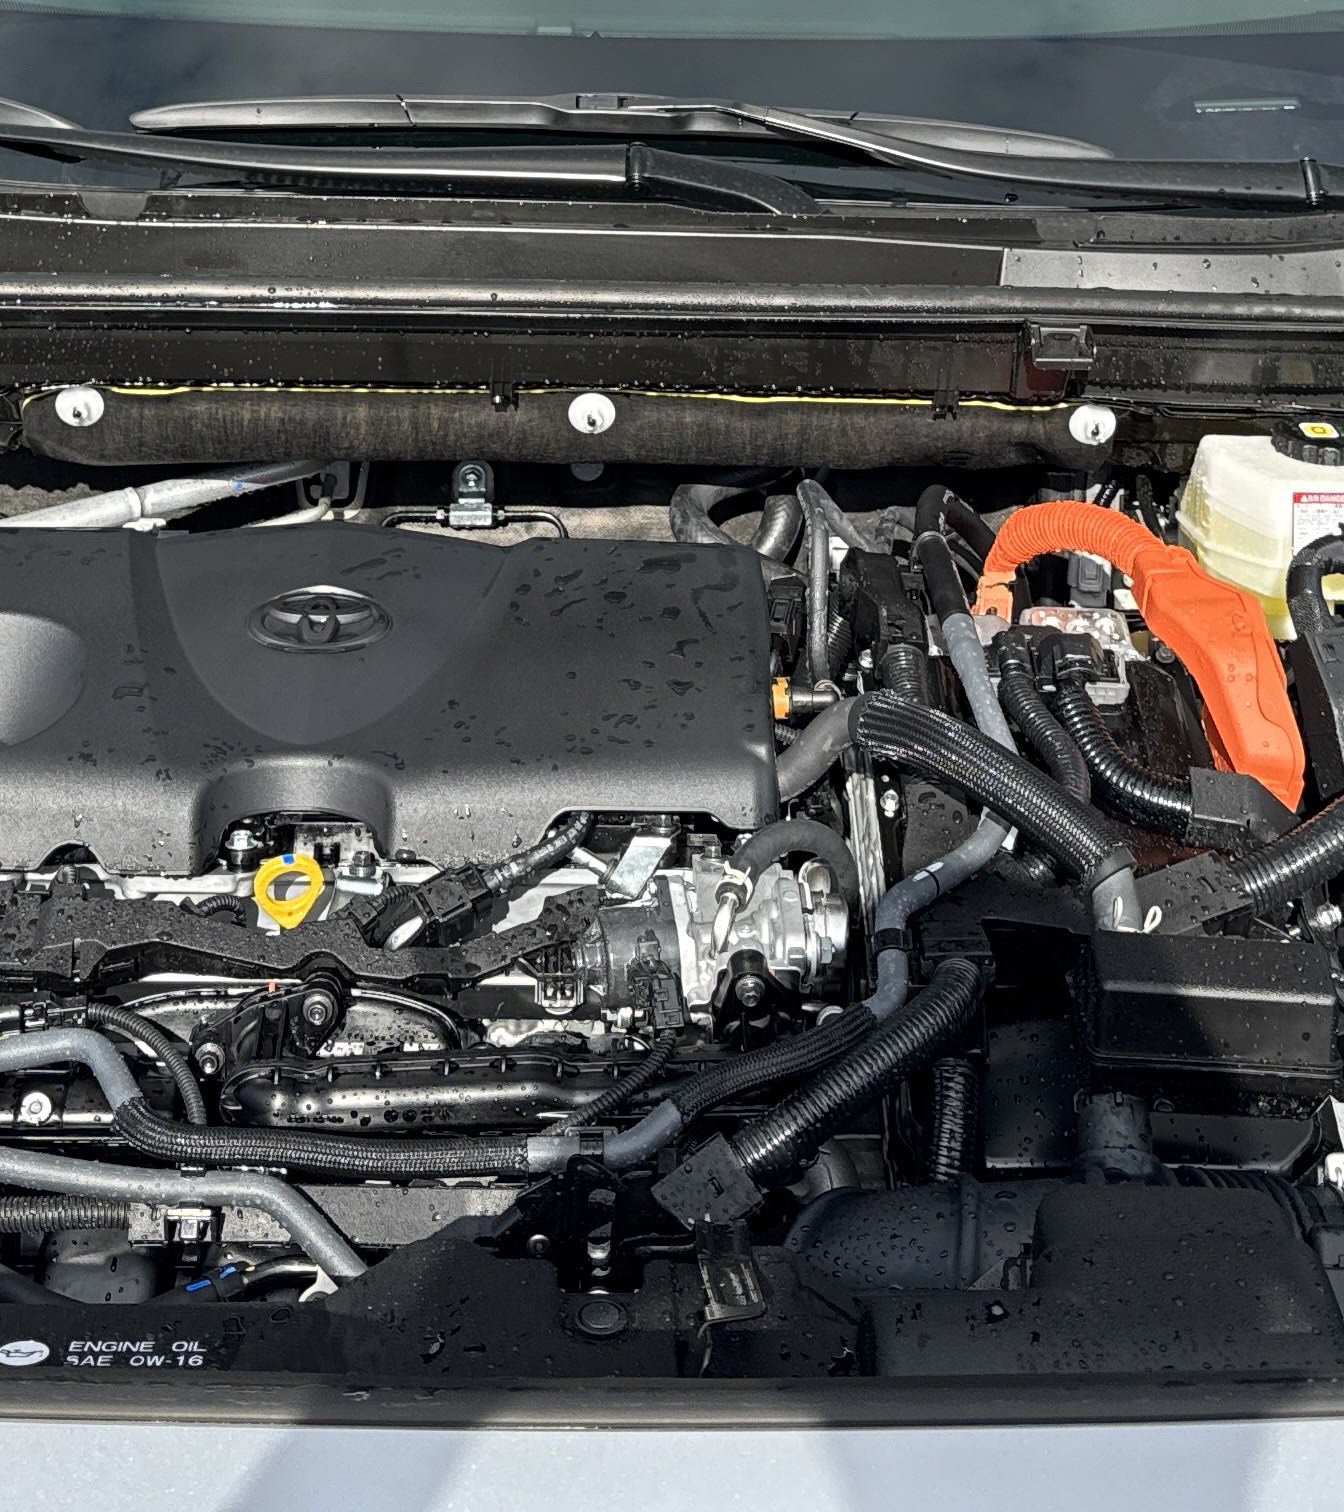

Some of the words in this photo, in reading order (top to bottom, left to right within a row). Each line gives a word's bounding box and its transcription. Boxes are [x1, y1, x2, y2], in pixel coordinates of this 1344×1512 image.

[68, 1341, 155, 1353] ENGINE
[171, 1341, 207, 1353] OIL
[65, 1354, 113, 1367] SAE
[129, 1354, 204, 1367] 0W-16
